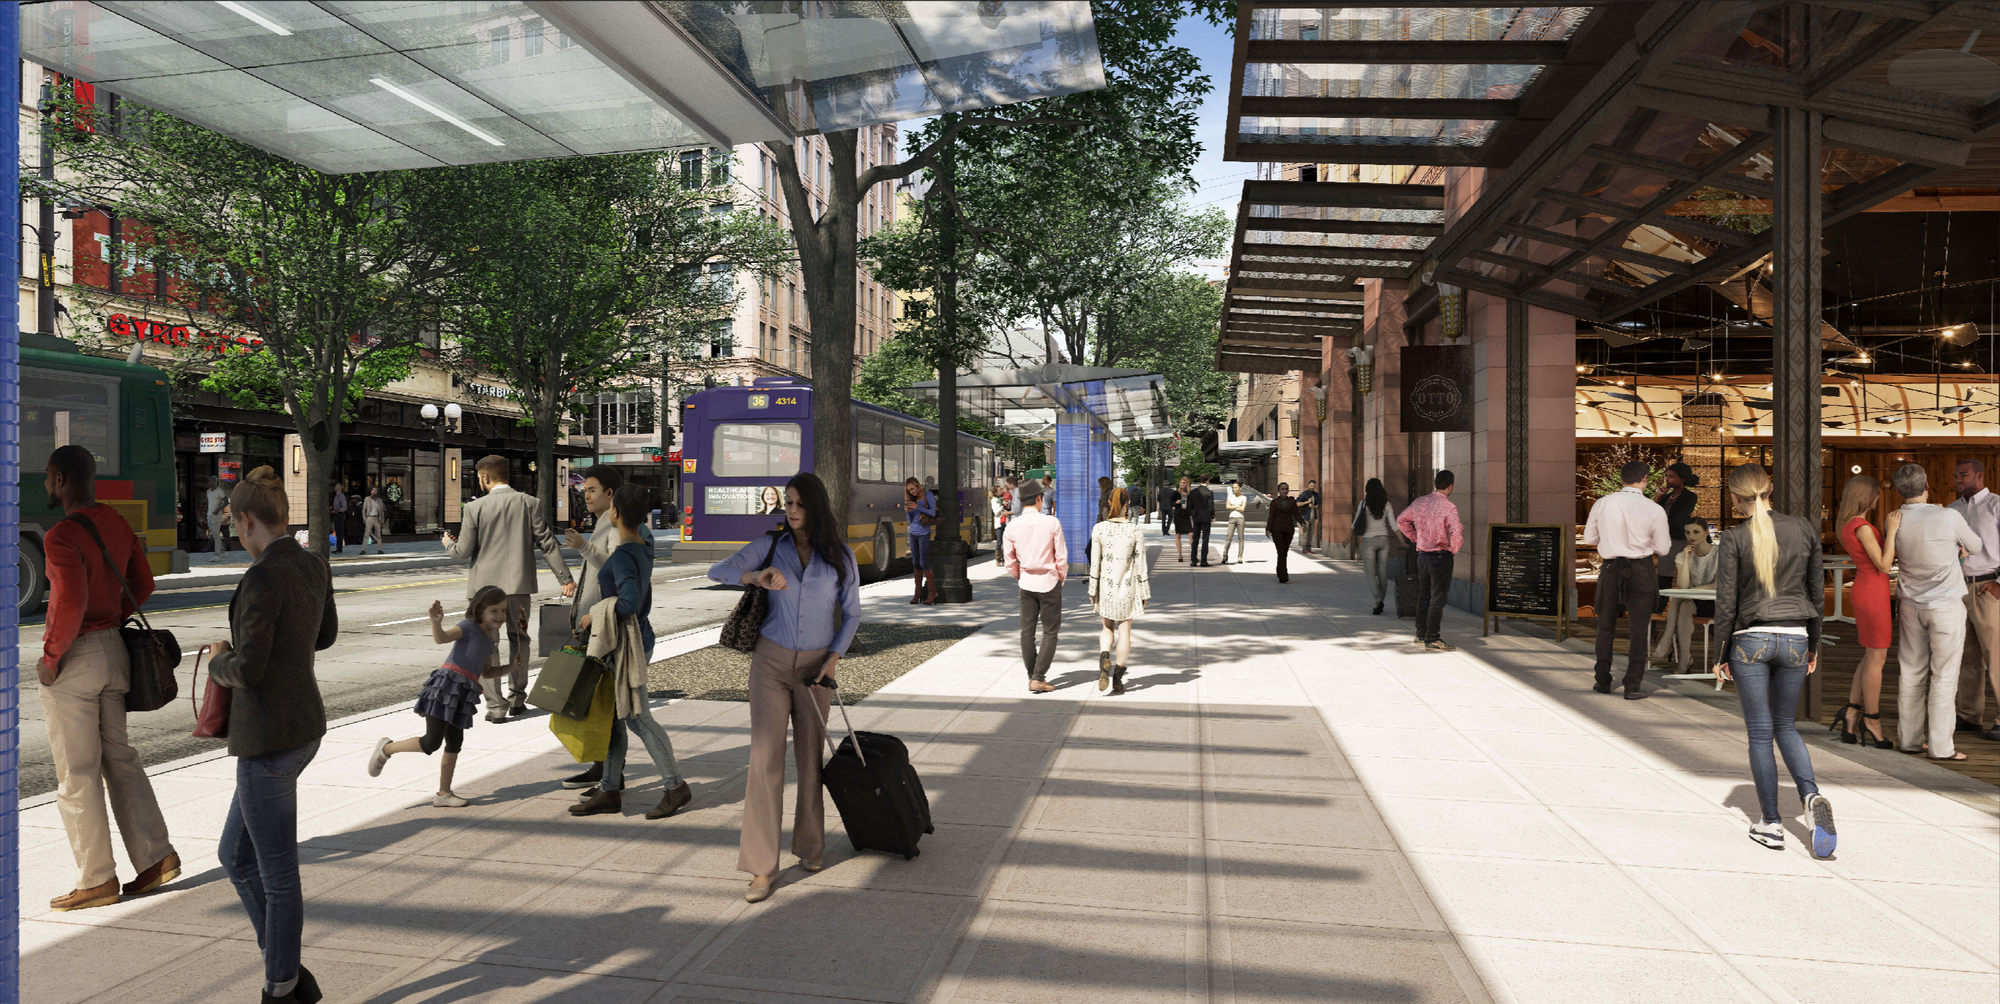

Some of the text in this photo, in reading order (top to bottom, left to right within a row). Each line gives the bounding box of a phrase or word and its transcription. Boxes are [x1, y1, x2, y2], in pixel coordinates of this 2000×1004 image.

[107, 313, 190, 347] GYRO
[752, 396, 797, 406] 36 4314
[1418, 392, 1454, 404] OTTO
[219, 472, 236, 480] OPEN
